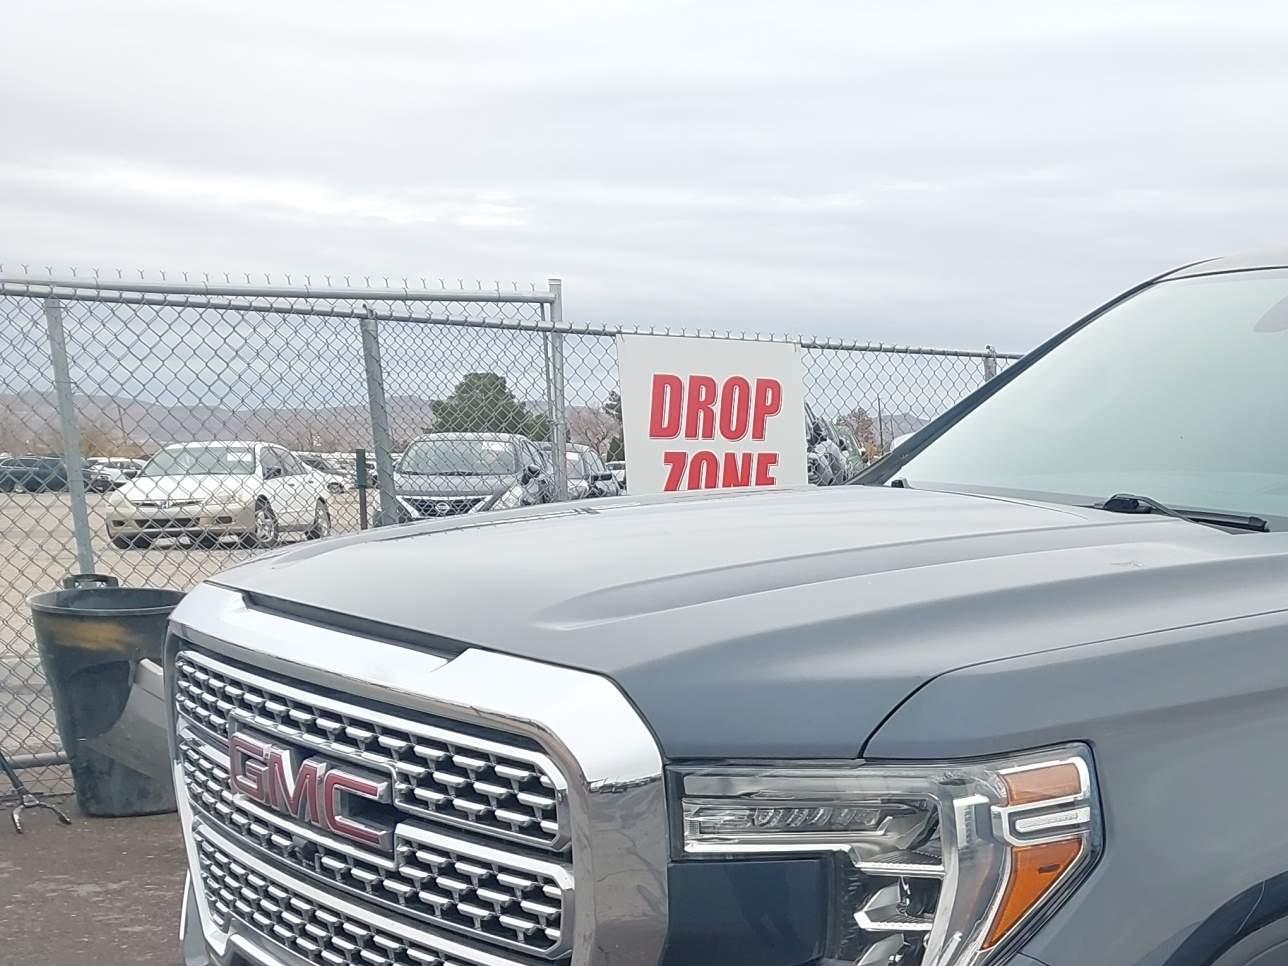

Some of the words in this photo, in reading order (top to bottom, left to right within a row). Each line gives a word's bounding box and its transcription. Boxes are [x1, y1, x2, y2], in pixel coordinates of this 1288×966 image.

[649, 373, 782, 441] DROP
[663, 450, 779, 491] ZONE
[230, 732, 392, 852] GMC
